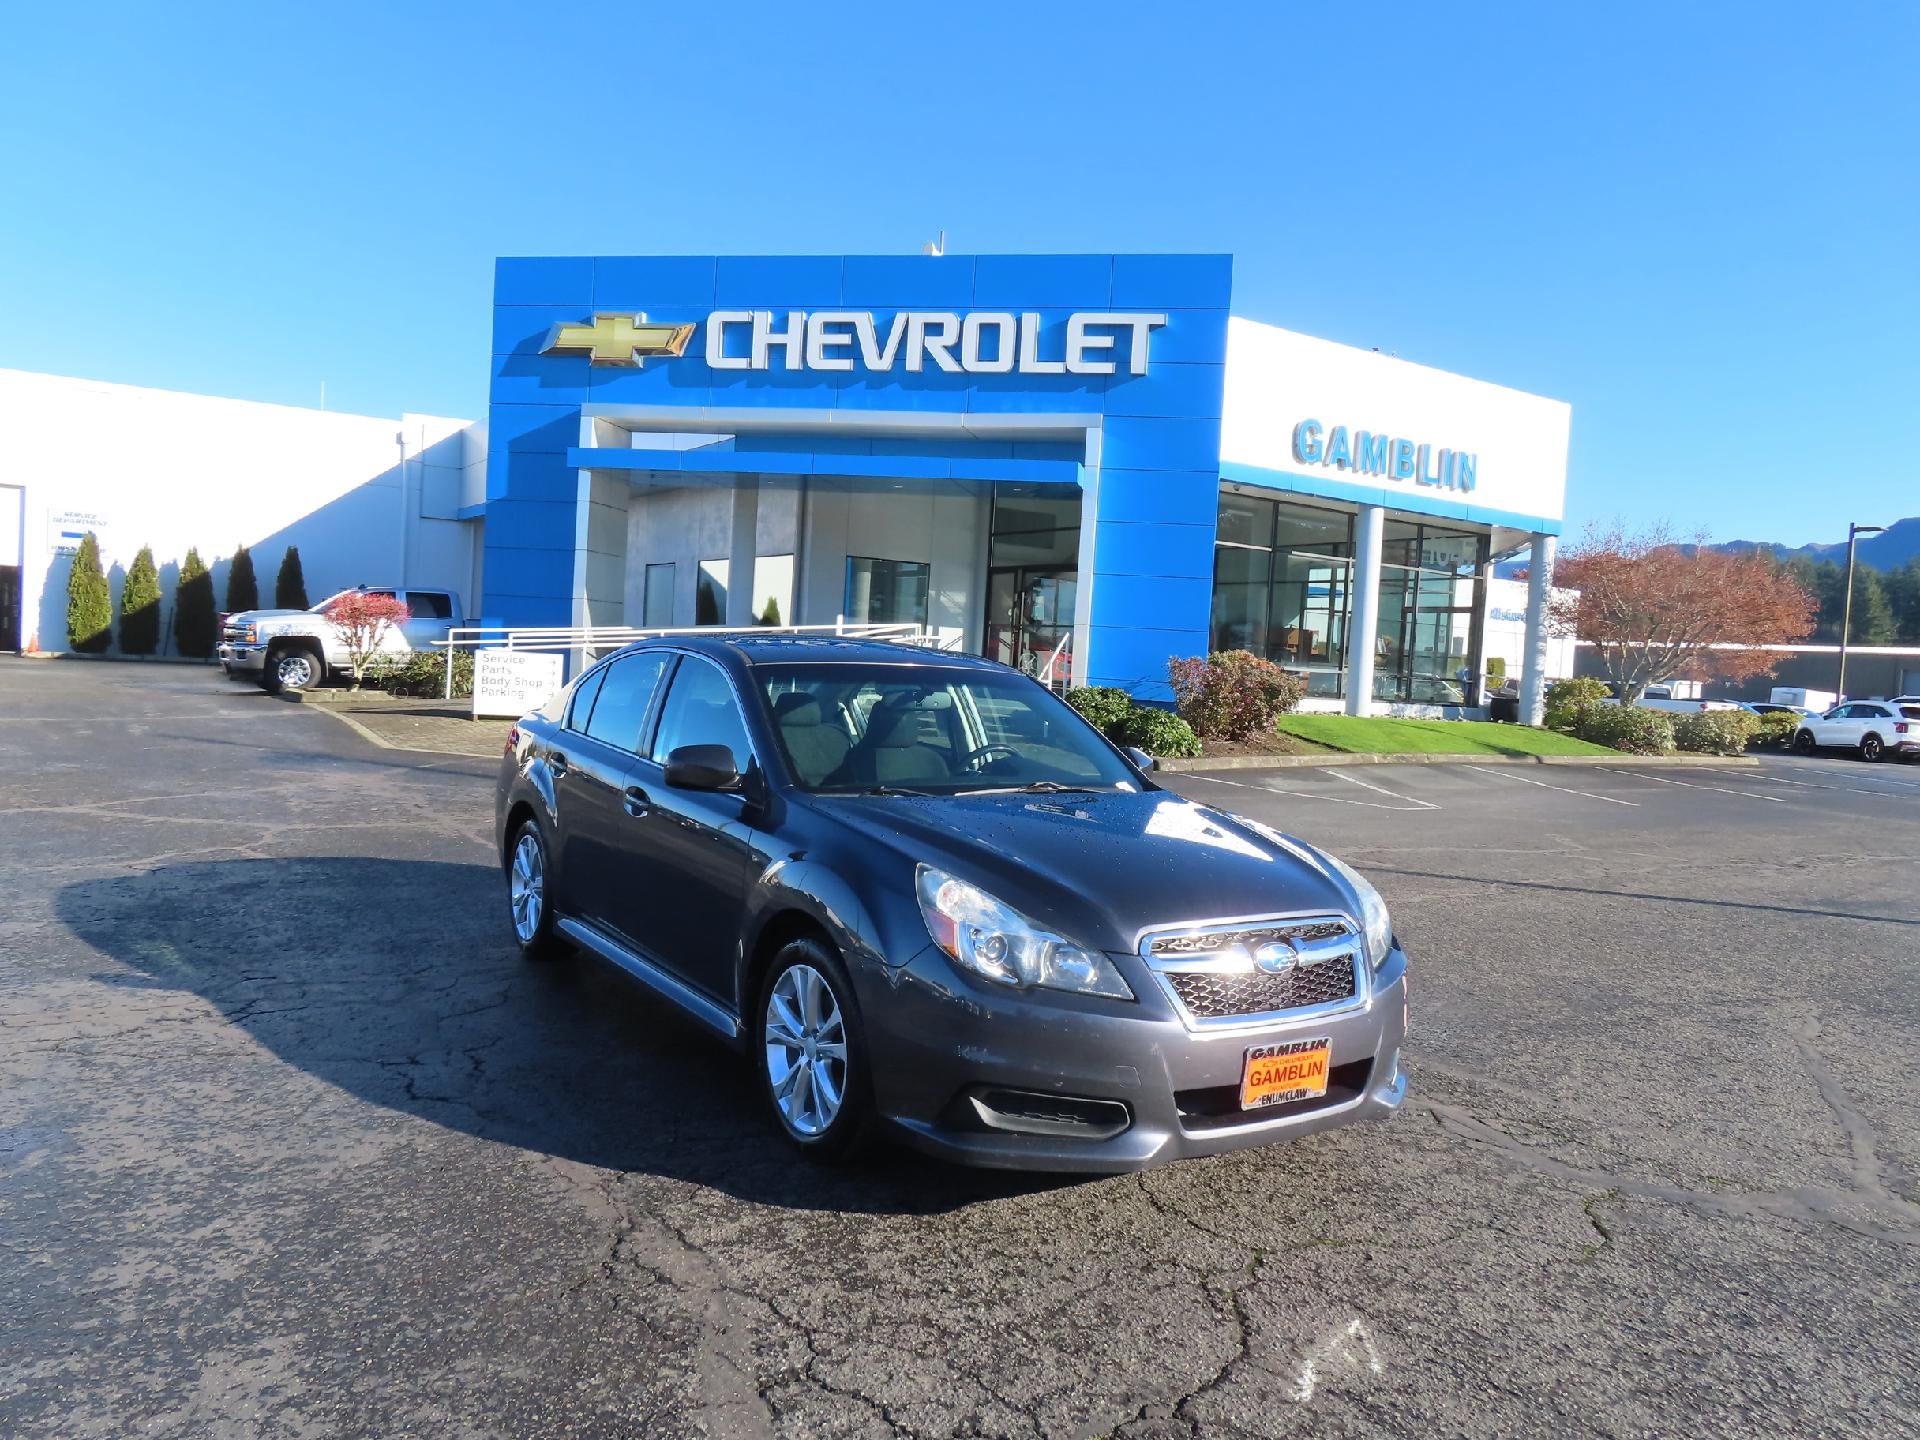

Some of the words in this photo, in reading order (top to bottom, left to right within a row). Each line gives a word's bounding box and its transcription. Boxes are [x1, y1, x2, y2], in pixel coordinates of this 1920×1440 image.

[706, 311, 1168, 376] CHEVROLET
[1292, 418, 1477, 493] GAMBLIN
[482, 653, 525, 664] Service
[481, 664, 512, 675] Parts
[481, 676, 511, 688] Body
[514, 677, 543, 688] Shop
[481, 686, 525, 700] Parking
[1251, 1038, 1328, 1060] GAMBLIN
[1250, 1060, 1323, 1087] GAMBLIN
[1262, 1088, 1308, 1105] ENUMCLAW
